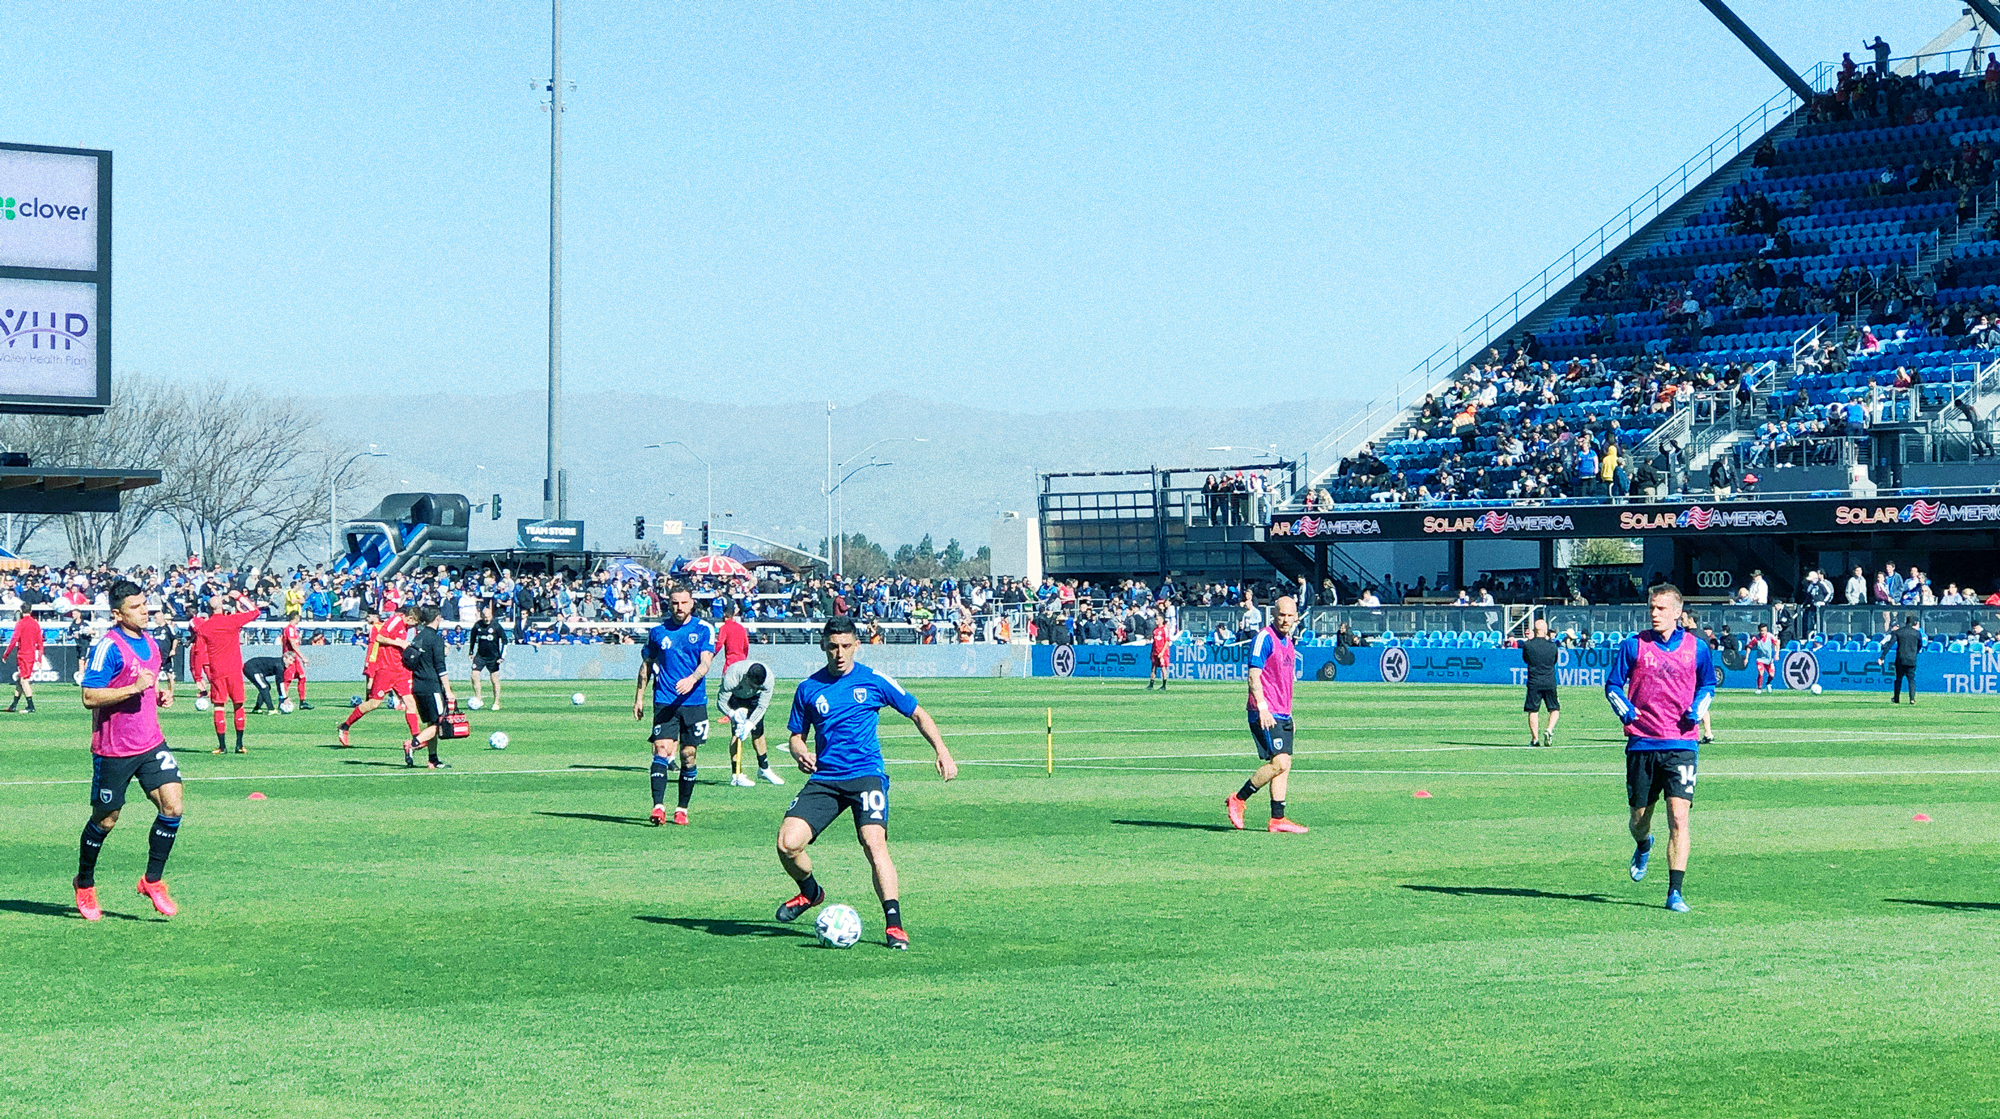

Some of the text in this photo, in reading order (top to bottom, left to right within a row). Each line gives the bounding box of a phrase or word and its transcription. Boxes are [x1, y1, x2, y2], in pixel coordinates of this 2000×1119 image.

[19, 198, 88, 221] clover
[525, 526, 577, 536] TEAM STORE
[1175, 645, 1207, 663] FIND
[1969, 652, 2000, 673] FIN
[1167, 662, 1249, 680] RUE WIRELE
[1942, 674, 1998, 693] TRUE
[815, 702, 830, 715] 10
[693, 719, 710, 741] 37
[1677, 764, 1696, 786] 14
[860, 789, 886, 812] 10
